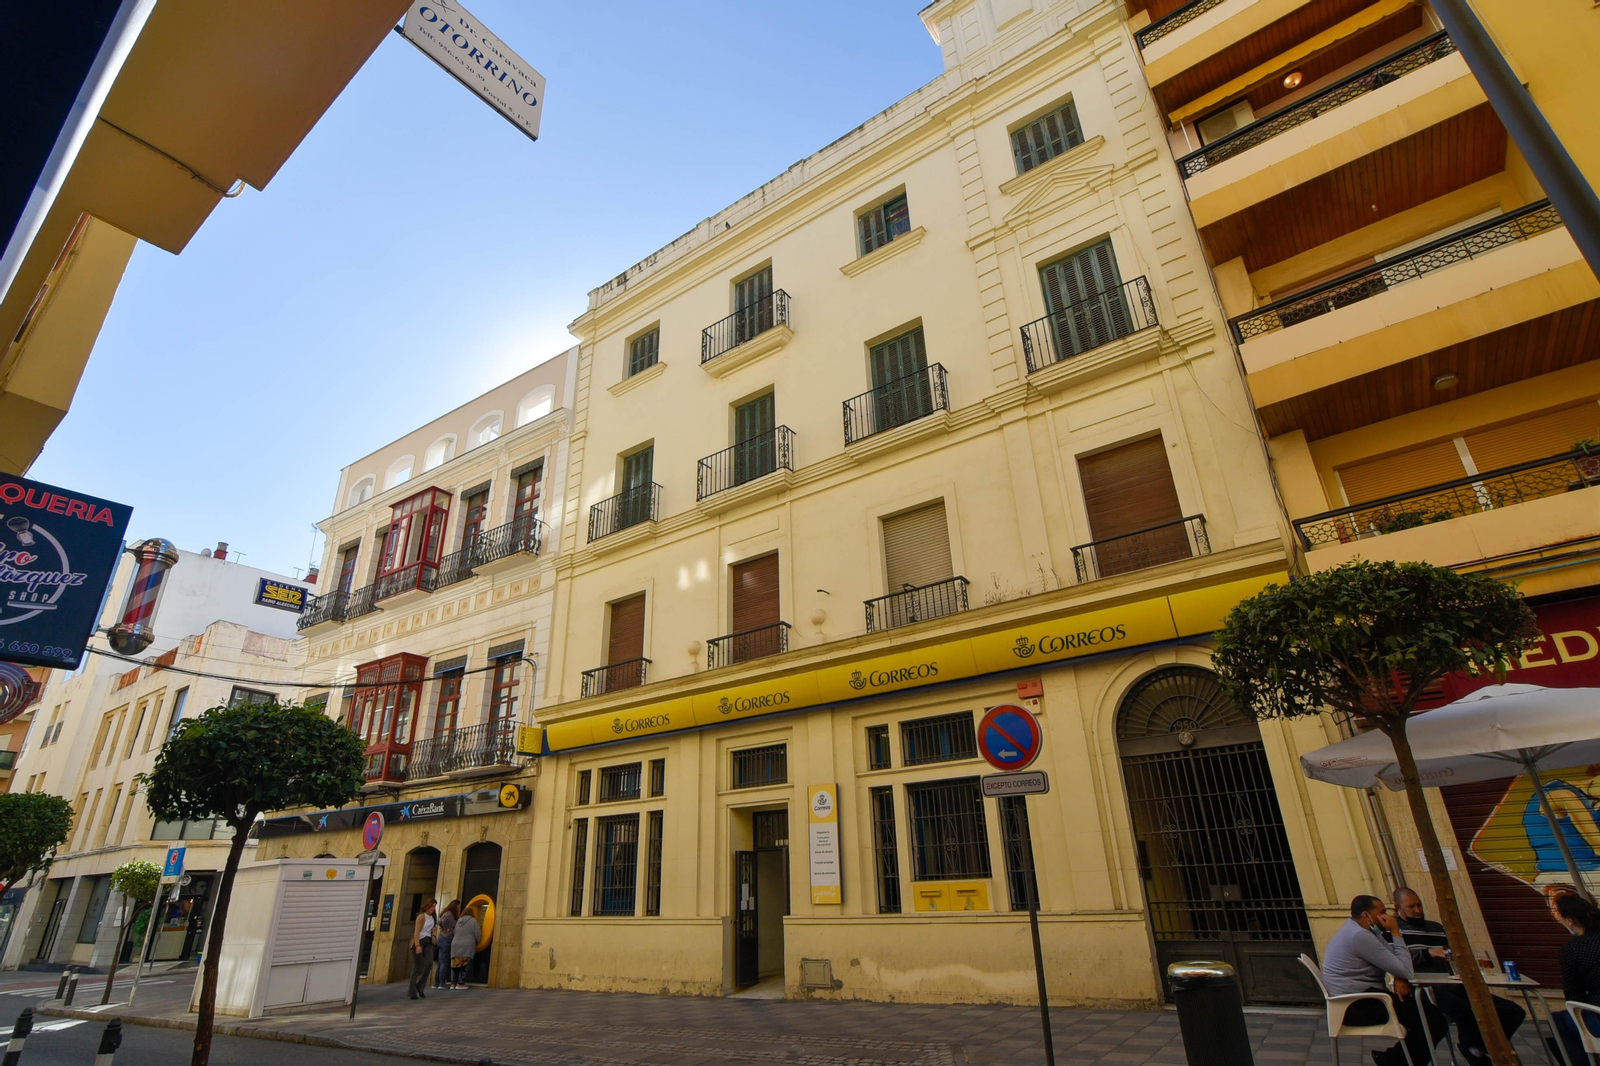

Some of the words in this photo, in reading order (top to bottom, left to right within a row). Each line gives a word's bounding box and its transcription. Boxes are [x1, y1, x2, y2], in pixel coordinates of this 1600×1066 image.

[419, 6, 538, 107] OTORRINO
[459, 16, 478, 38] Dr.
[482, 38, 537, 88] Caravaca
[0, 483, 114, 527] QUERIA
[9, 590, 49, 603] SHOP
[262, 584, 302, 606] SER
[8, 640, 40, 655] 660
[1038, 623, 1127, 655] CORREOS
[869, 661, 939, 688] CORREOS
[734, 690, 790, 713] CORREOS
[624, 713, 671, 733] CORREOS
[986, 781, 1012, 790] EXCEPTO
[1012, 778, 1042, 788] CORREOS
[412, 801, 445, 815] CaixaBank
